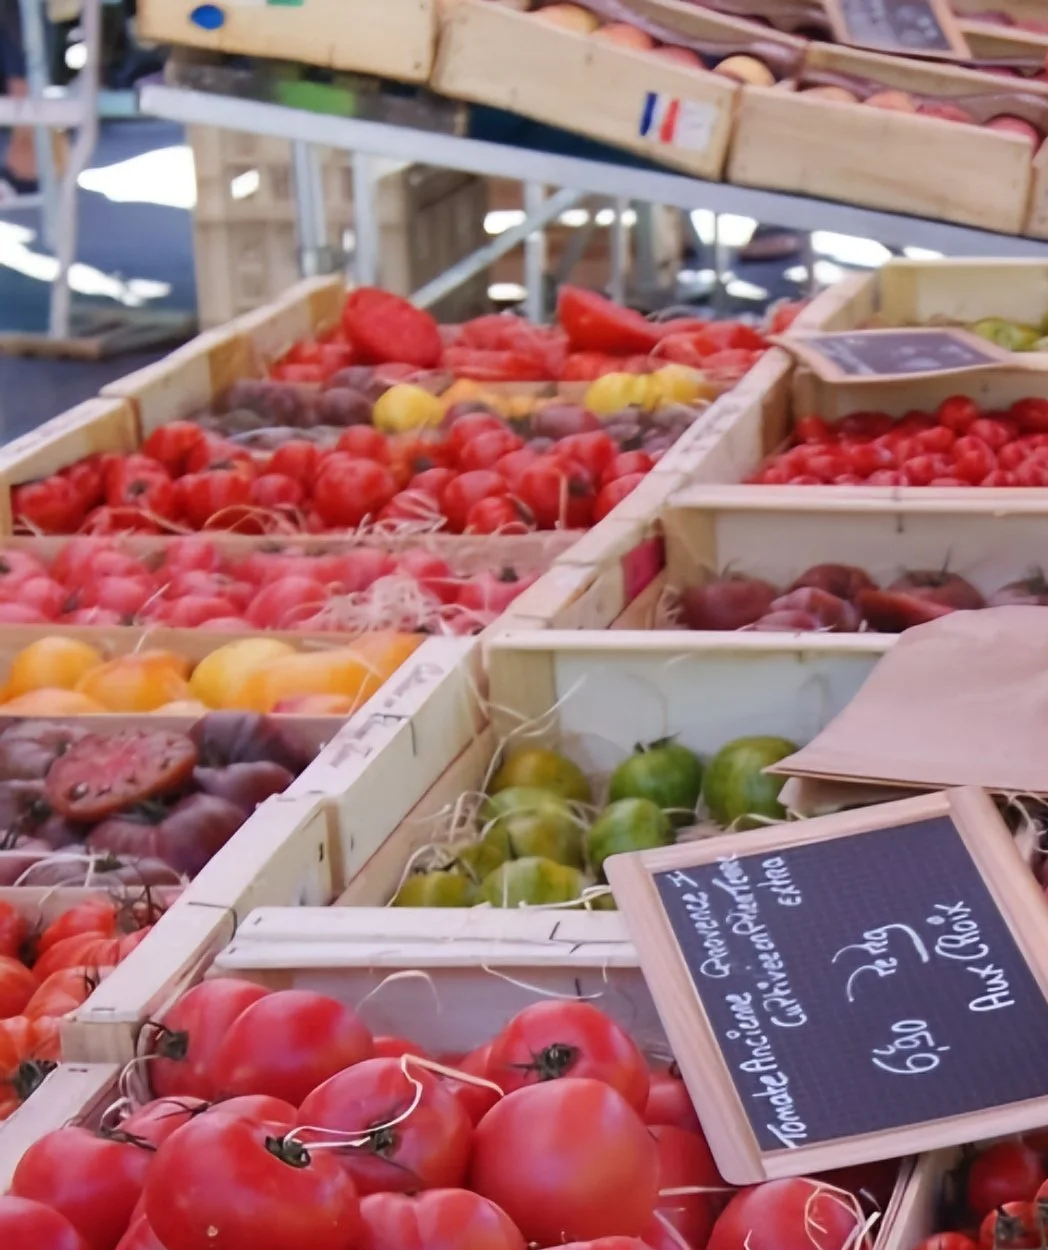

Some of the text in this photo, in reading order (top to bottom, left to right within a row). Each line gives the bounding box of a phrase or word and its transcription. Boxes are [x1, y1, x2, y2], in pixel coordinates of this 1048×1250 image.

[682, 890, 731, 979] Provence
[967, 963, 1016, 1012] Aux
[751, 1071, 807, 1150] Tomate
